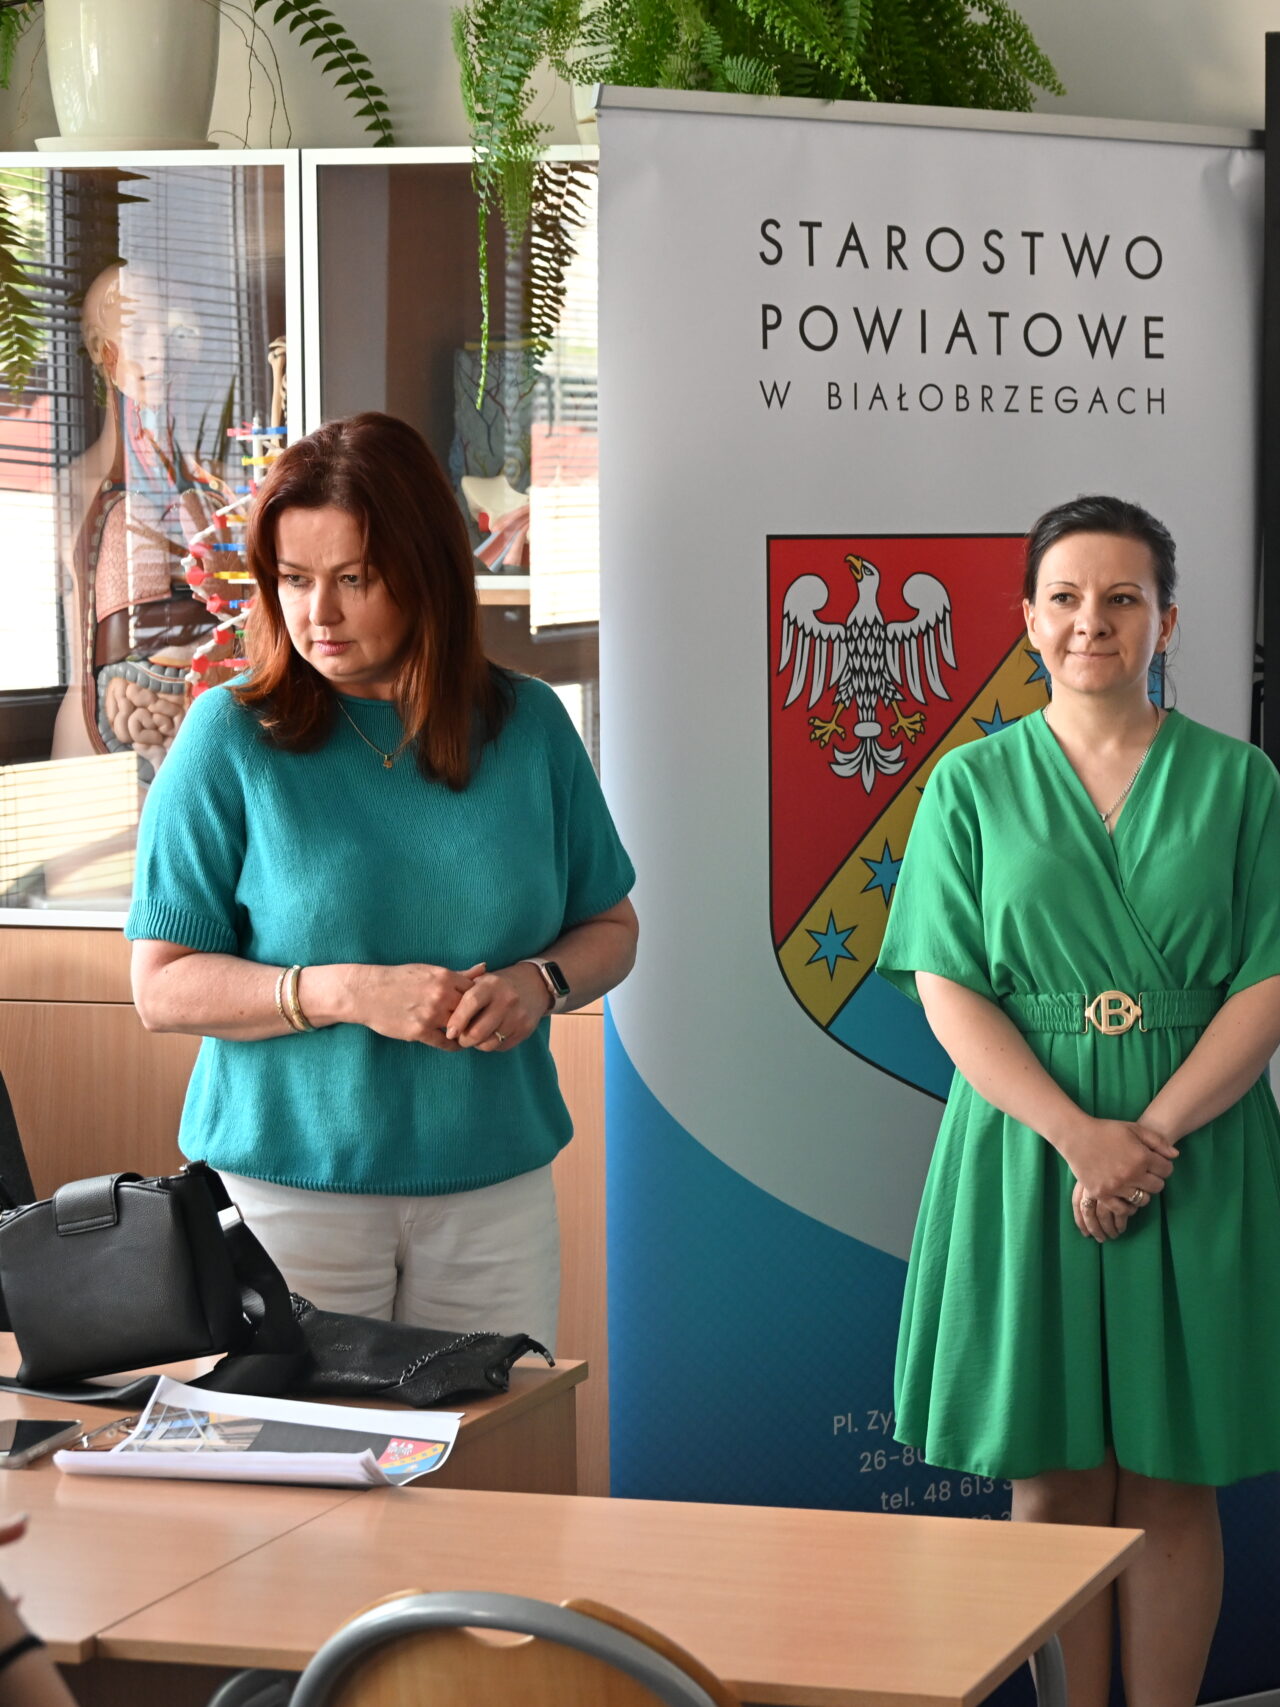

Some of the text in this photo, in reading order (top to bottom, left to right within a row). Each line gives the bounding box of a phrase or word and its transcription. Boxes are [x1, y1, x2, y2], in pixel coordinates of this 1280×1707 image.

[759, 218, 1163, 280] STAROSTWO
[761, 303, 1165, 360] POWIATOWE
[759, 380, 1166, 415] W BIAŁOBRZEGACH
[833, 1409, 895, 1436] Pl. Zy
[880, 1486, 916, 1511] tel.
[923, 1480, 951, 1503] 48
[960, 1476, 994, 1497] 613
